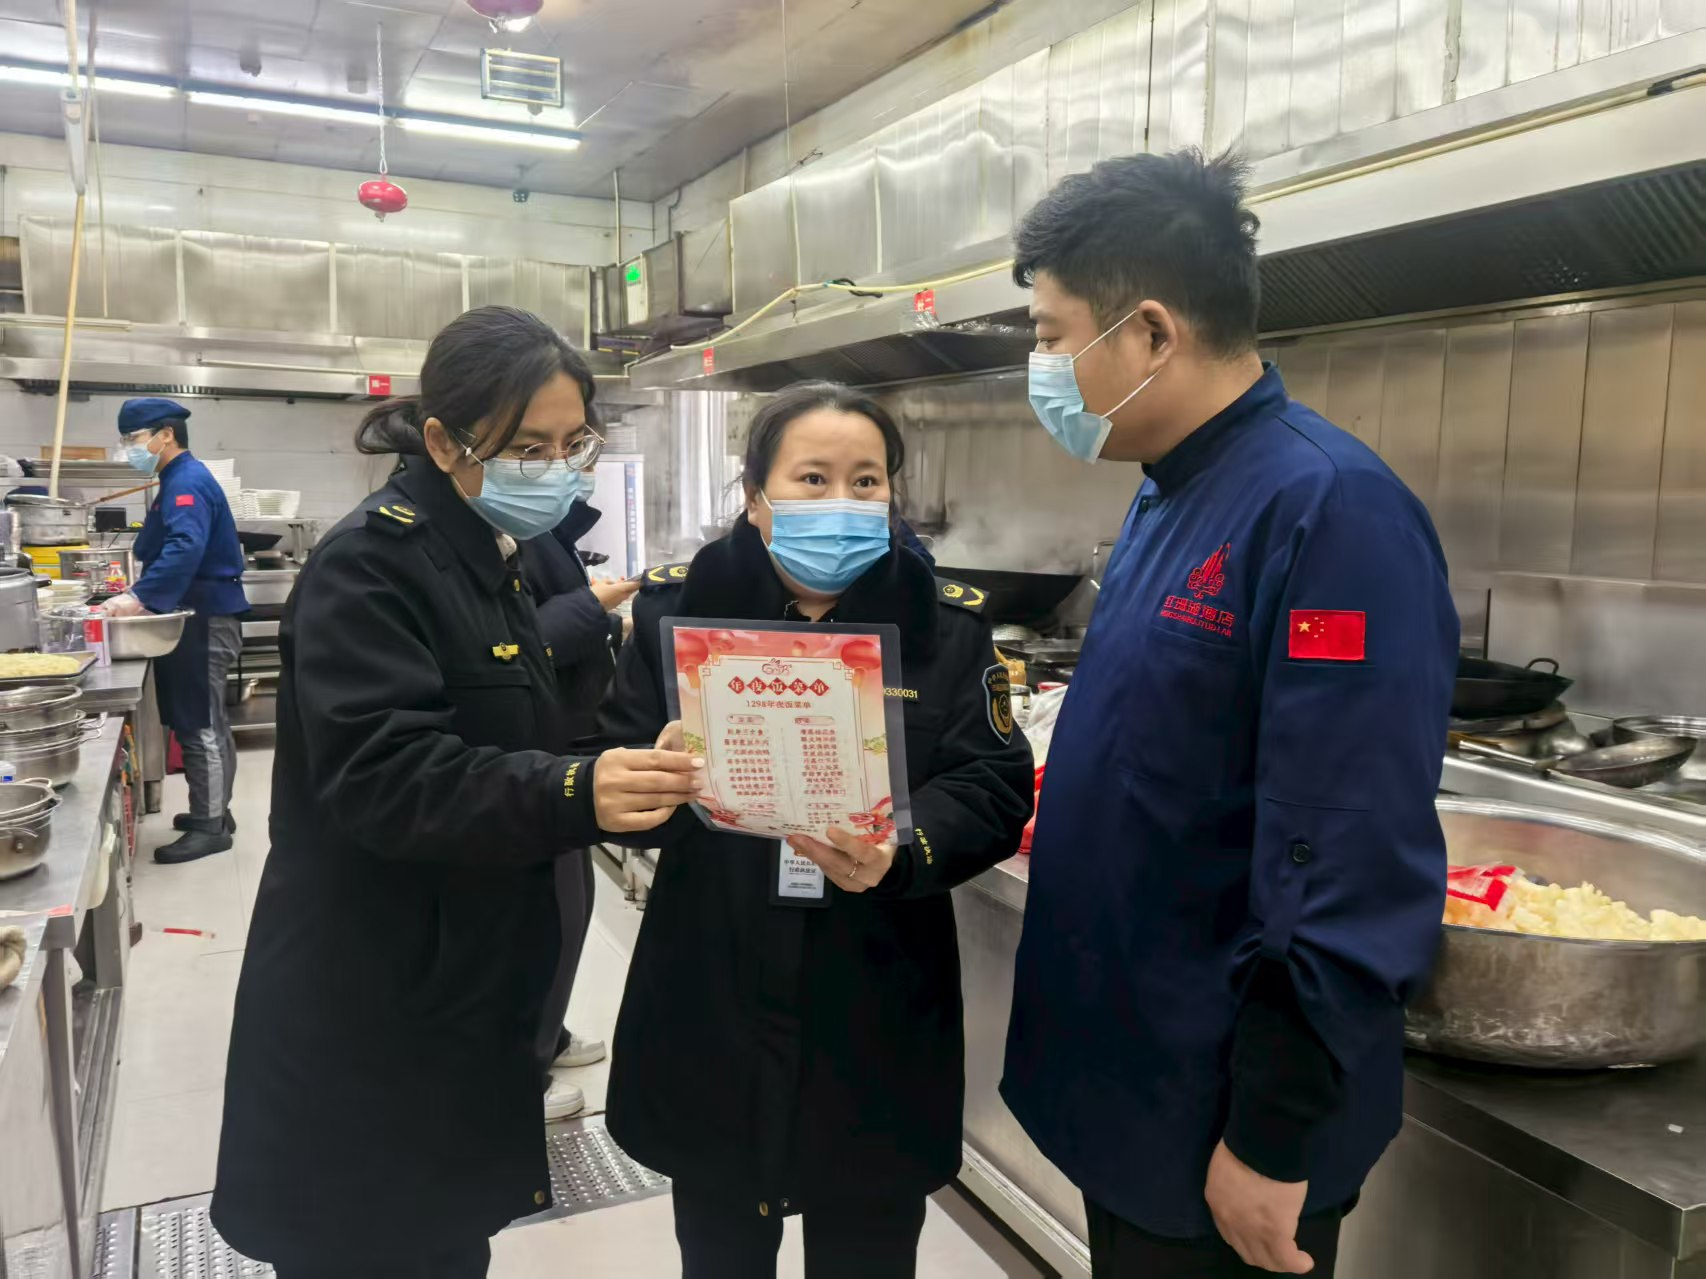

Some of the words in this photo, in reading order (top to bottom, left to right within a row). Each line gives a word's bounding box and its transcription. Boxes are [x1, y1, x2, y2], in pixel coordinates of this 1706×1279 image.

[728, 677, 828, 696] 年夜饭菜单
[882, 687, 918, 698] 330031
[746, 700, 811, 709] 1298年夜饭菜单
